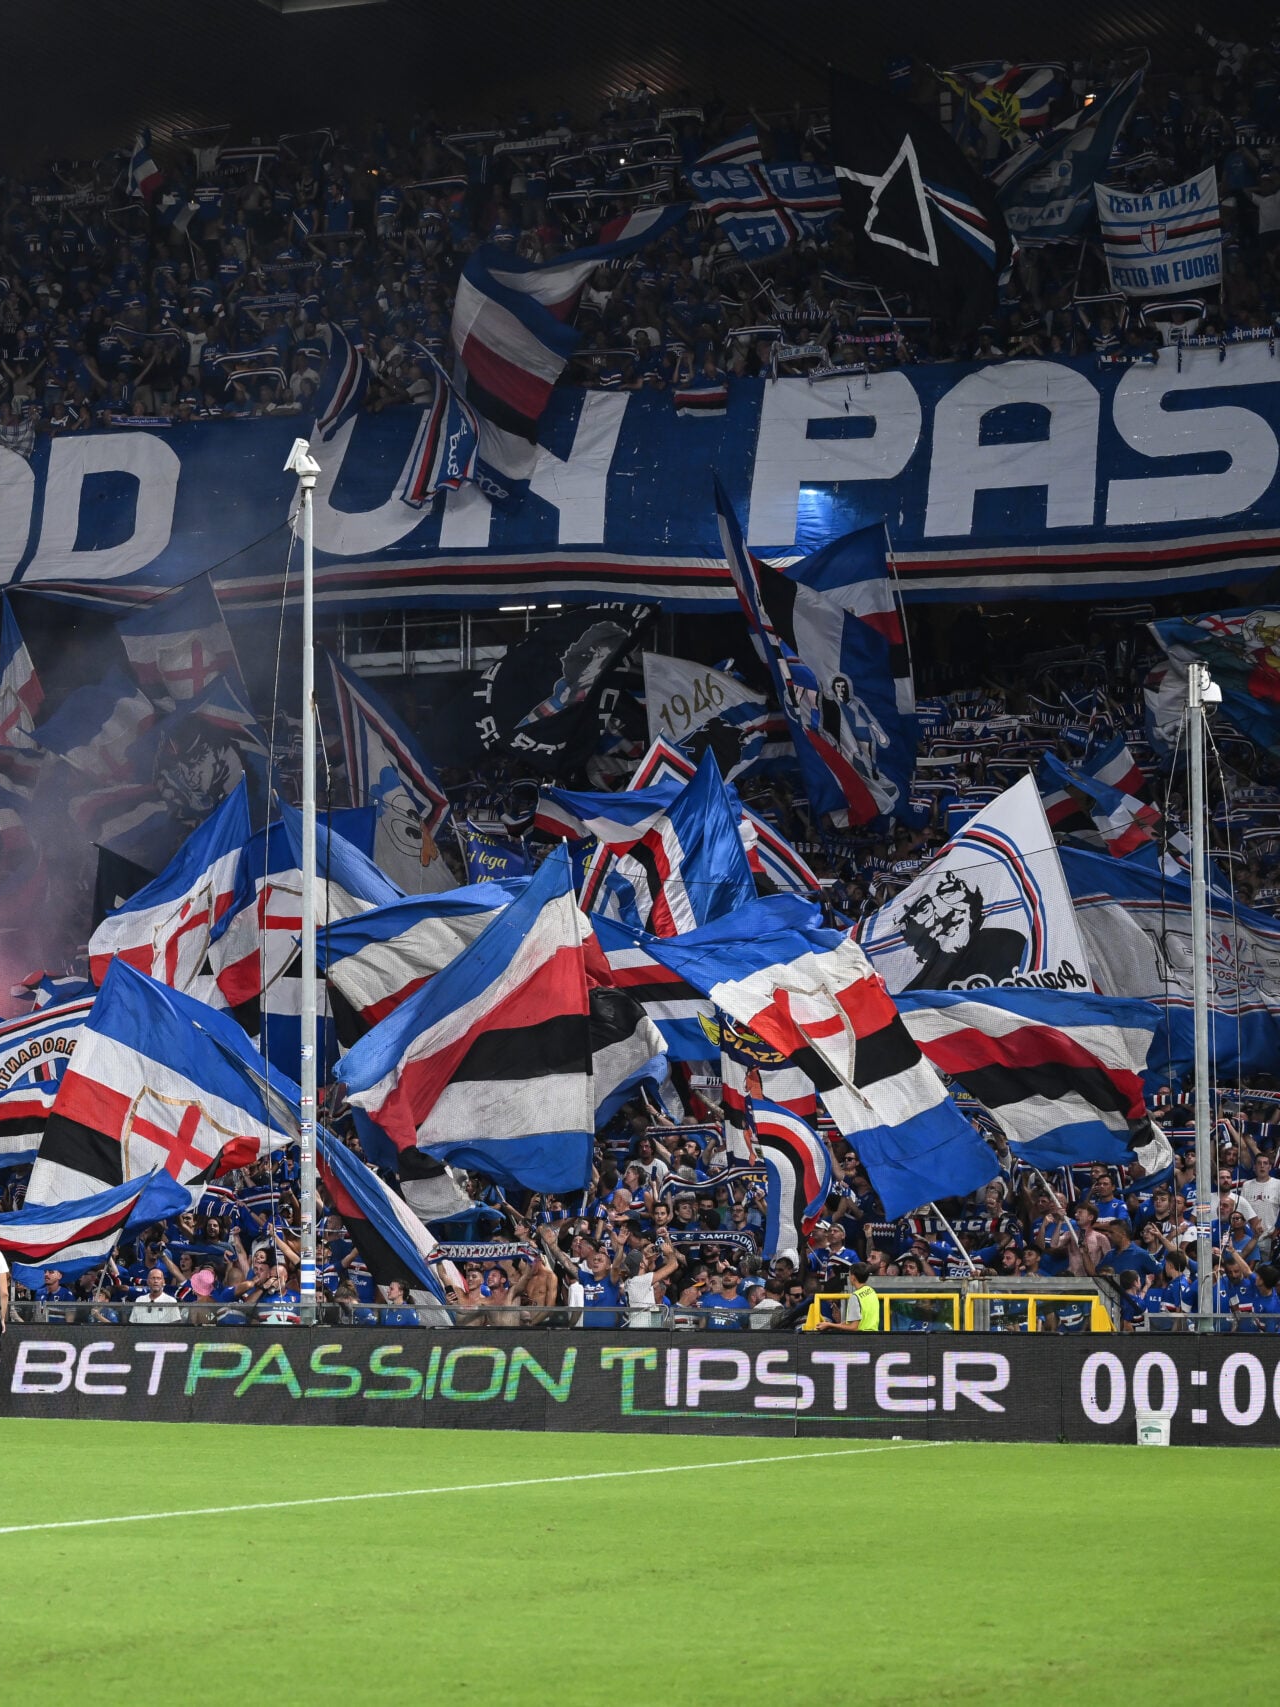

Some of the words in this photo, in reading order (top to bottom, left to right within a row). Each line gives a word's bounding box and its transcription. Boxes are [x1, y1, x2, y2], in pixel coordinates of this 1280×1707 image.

[1109, 194, 1153, 213] TESTA
[1158, 182, 1201, 210] ALTA
[1112, 265, 1148, 288] PETTO
[1151, 263, 1170, 286] IN
[1173, 253, 1220, 282] FUORI
[747, 344, 1279, 547] PAS
[660, 672, 724, 737] 1946
[478, 850, 508, 870] lega
[439, 1244, 518, 1259] SAMPDORIA
[11, 1341, 578, 1403] BETPASSION
[601, 1346, 1011, 1414] TIPSTER
[1081, 1350, 1280, 1426] 00:0
